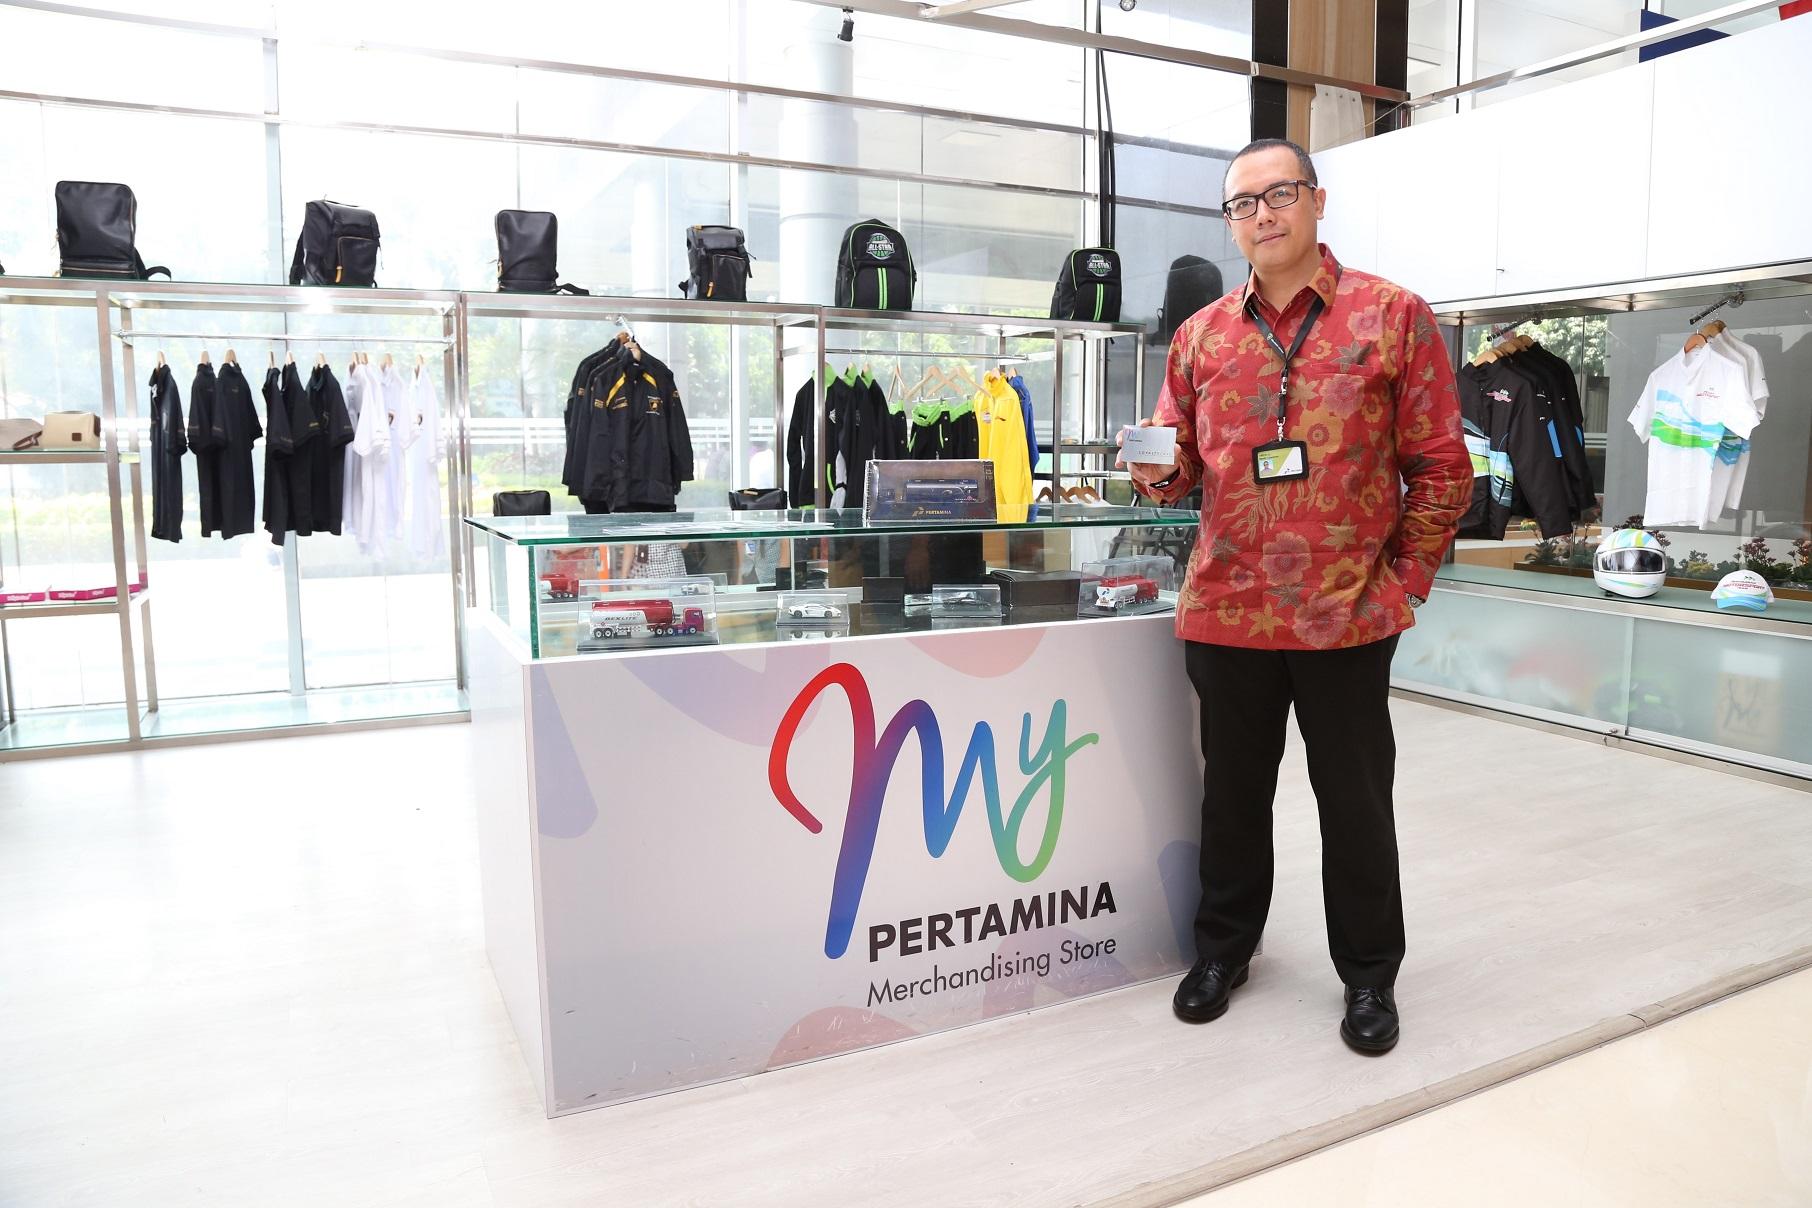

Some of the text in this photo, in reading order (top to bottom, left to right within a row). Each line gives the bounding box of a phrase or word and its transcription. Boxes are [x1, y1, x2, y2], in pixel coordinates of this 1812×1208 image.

[868, 881, 1117, 962] PERTAMINA
[867, 939, 1117, 1007] Merchandising Store
